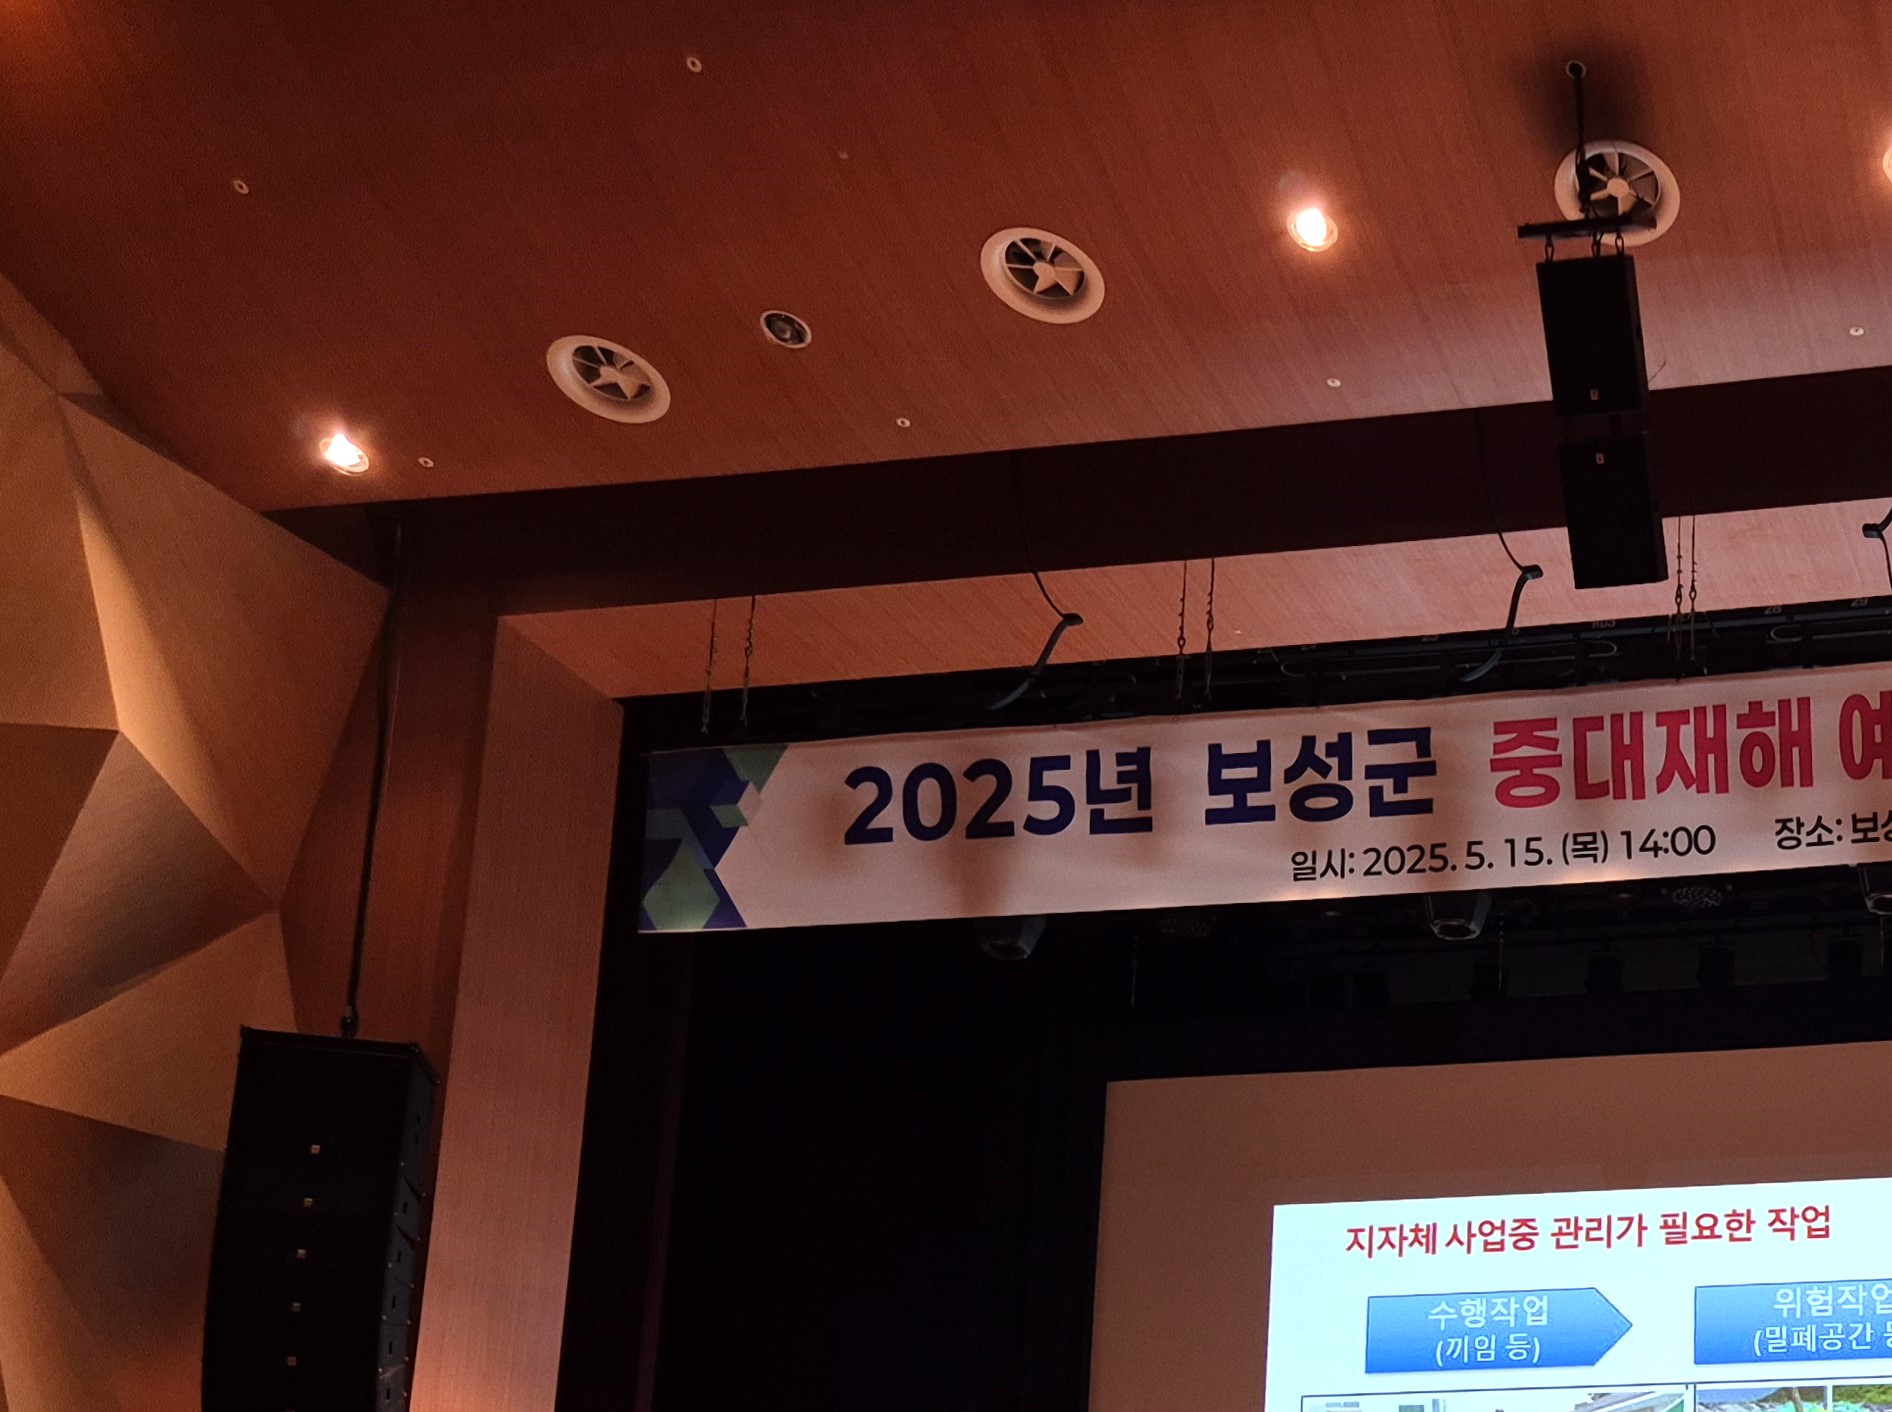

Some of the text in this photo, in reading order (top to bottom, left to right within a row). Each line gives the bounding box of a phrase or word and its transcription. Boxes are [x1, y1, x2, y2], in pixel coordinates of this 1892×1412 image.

[842, 744, 1154, 846] 2025년
[1204, 726, 1437, 827] 보성군
[1488, 697, 1814, 808] 중대재해
[1774, 815, 1843, 850] 장소:
[1291, 825, 1717, 881] 일시: 2025. 5. 15. (목) 14:00
[1345, 1205, 1831, 1258] 지자체 사업중 관리가 필요한 작업
[1428, 1295, 1548, 1331] 수행작업
[1435, 1333, 1541, 1367] (끼임 등)
[1754, 1322, 1874, 1356] (밀폐공간
